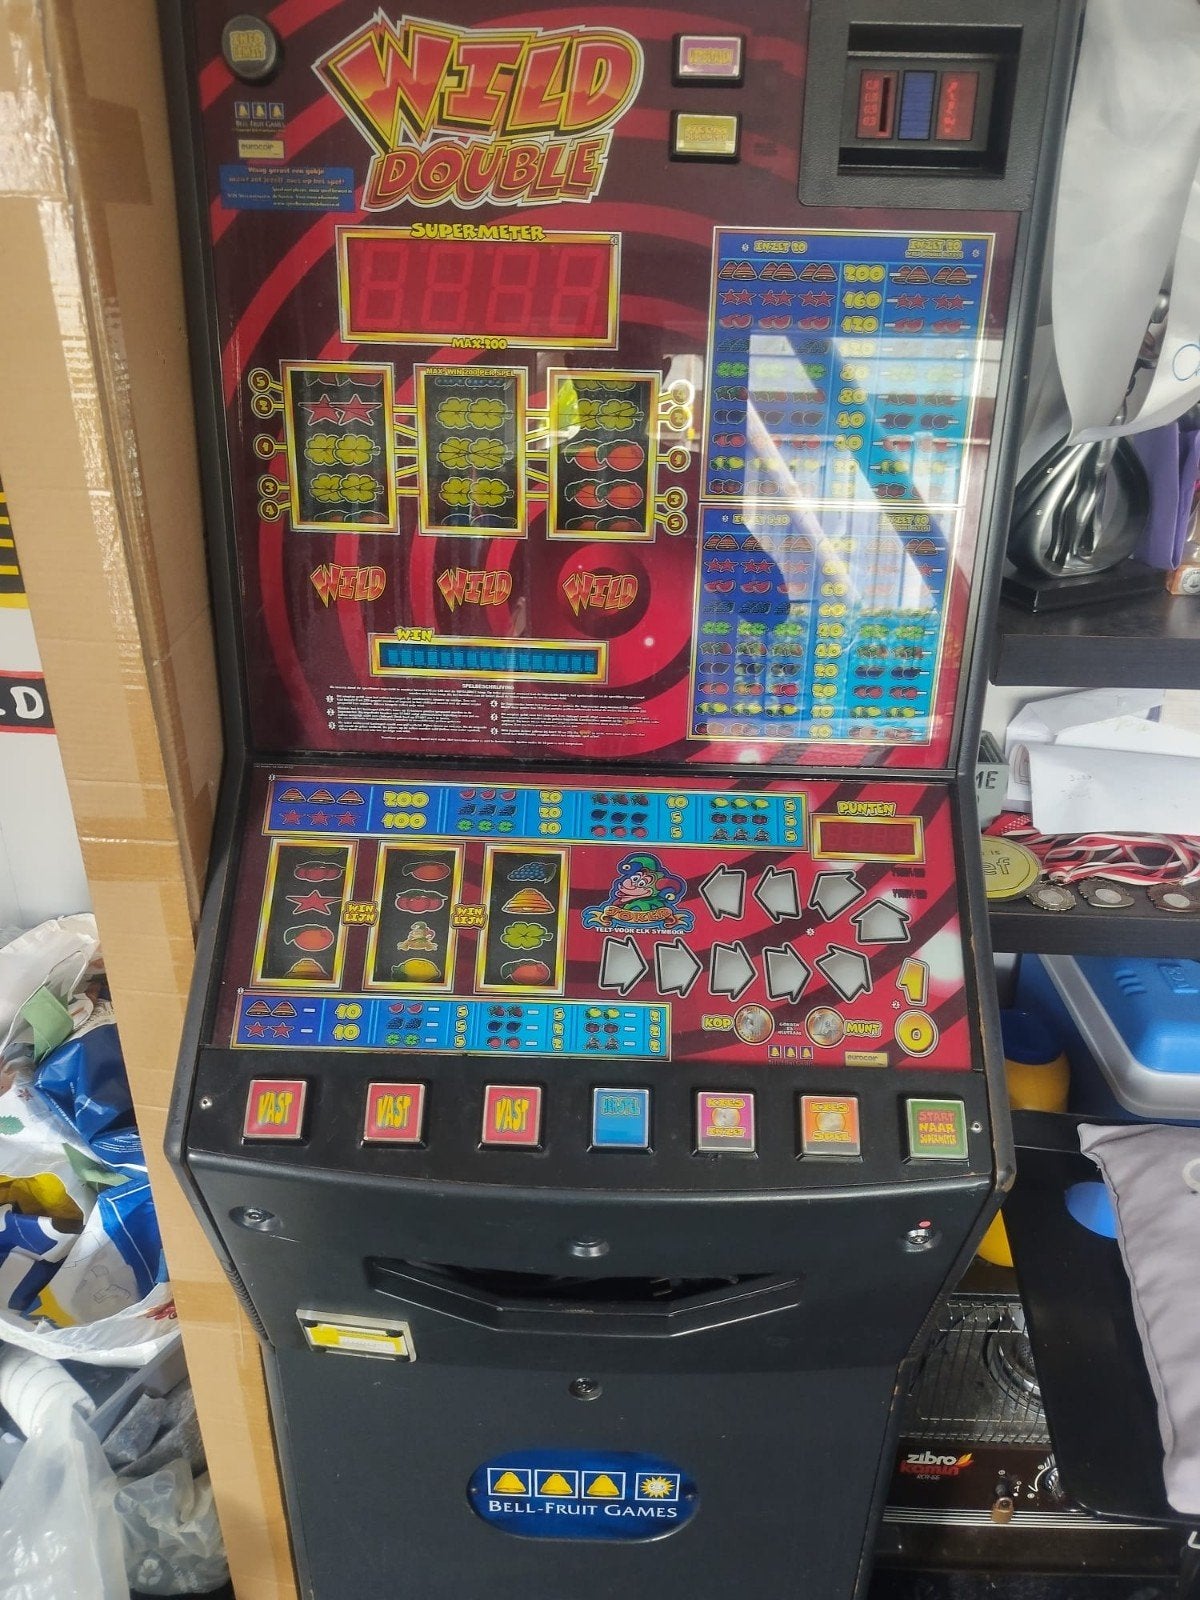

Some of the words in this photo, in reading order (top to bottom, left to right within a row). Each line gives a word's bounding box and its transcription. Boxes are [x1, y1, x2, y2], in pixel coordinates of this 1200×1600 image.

[316, 12, 642, 154] WILD
[372, 137, 606, 203] DOUBLE
[844, 265, 885, 283] 200
[843, 291, 882, 309] 160
[841, 316, 879, 333] 120
[447, 367, 463, 375] WIN
[496, 369, 516, 377] SPEL
[837, 387, 868, 405] 80
[310, 564, 386, 607] WILD
[437, 568, 513, 612] WILD
[562, 571, 638, 616] WILD
[397, 627, 432, 642] WIN
[814, 664, 840, 678] 20
[383, 790, 430, 808] 200
[666, 794, 689, 810] 10
[783, 797, 797, 813] 5
[837, 801, 896, 816] PUNTEN
[381, 812, 427, 829] 100
[669, 810, 684, 825] 5
[783, 813, 797, 827] 5
[669, 826, 684, 840] 5
[783, 828, 798, 844] 5
[348, 904, 375, 914] WIN
[456, 907, 483, 918] WIN
[606, 906, 670, 921] JOKER
[345, 913, 376, 923] LIJN
[454, 916, 484, 926] LIJN
[335, 1003, 362, 1020] 10
[456, 1006, 468, 1018] 5
[455, 1020, 467, 1033] 5
[703, 1017, 733, 1028] KOP
[845, 1021, 881, 1036] MUNT
[332, 1024, 361, 1041] 10
[454, 1034, 466, 1048] 5
[257, 1092, 293, 1125] VAST
[376, 1095, 411, 1128] VAST
[495, 1099, 530, 1132] VAST
[919, 1111, 955, 1122] START
[918, 1123, 956, 1133] NAAR
[907, 1451, 957, 1465] zibro
[604, 1504, 678, 1518] GAMES
